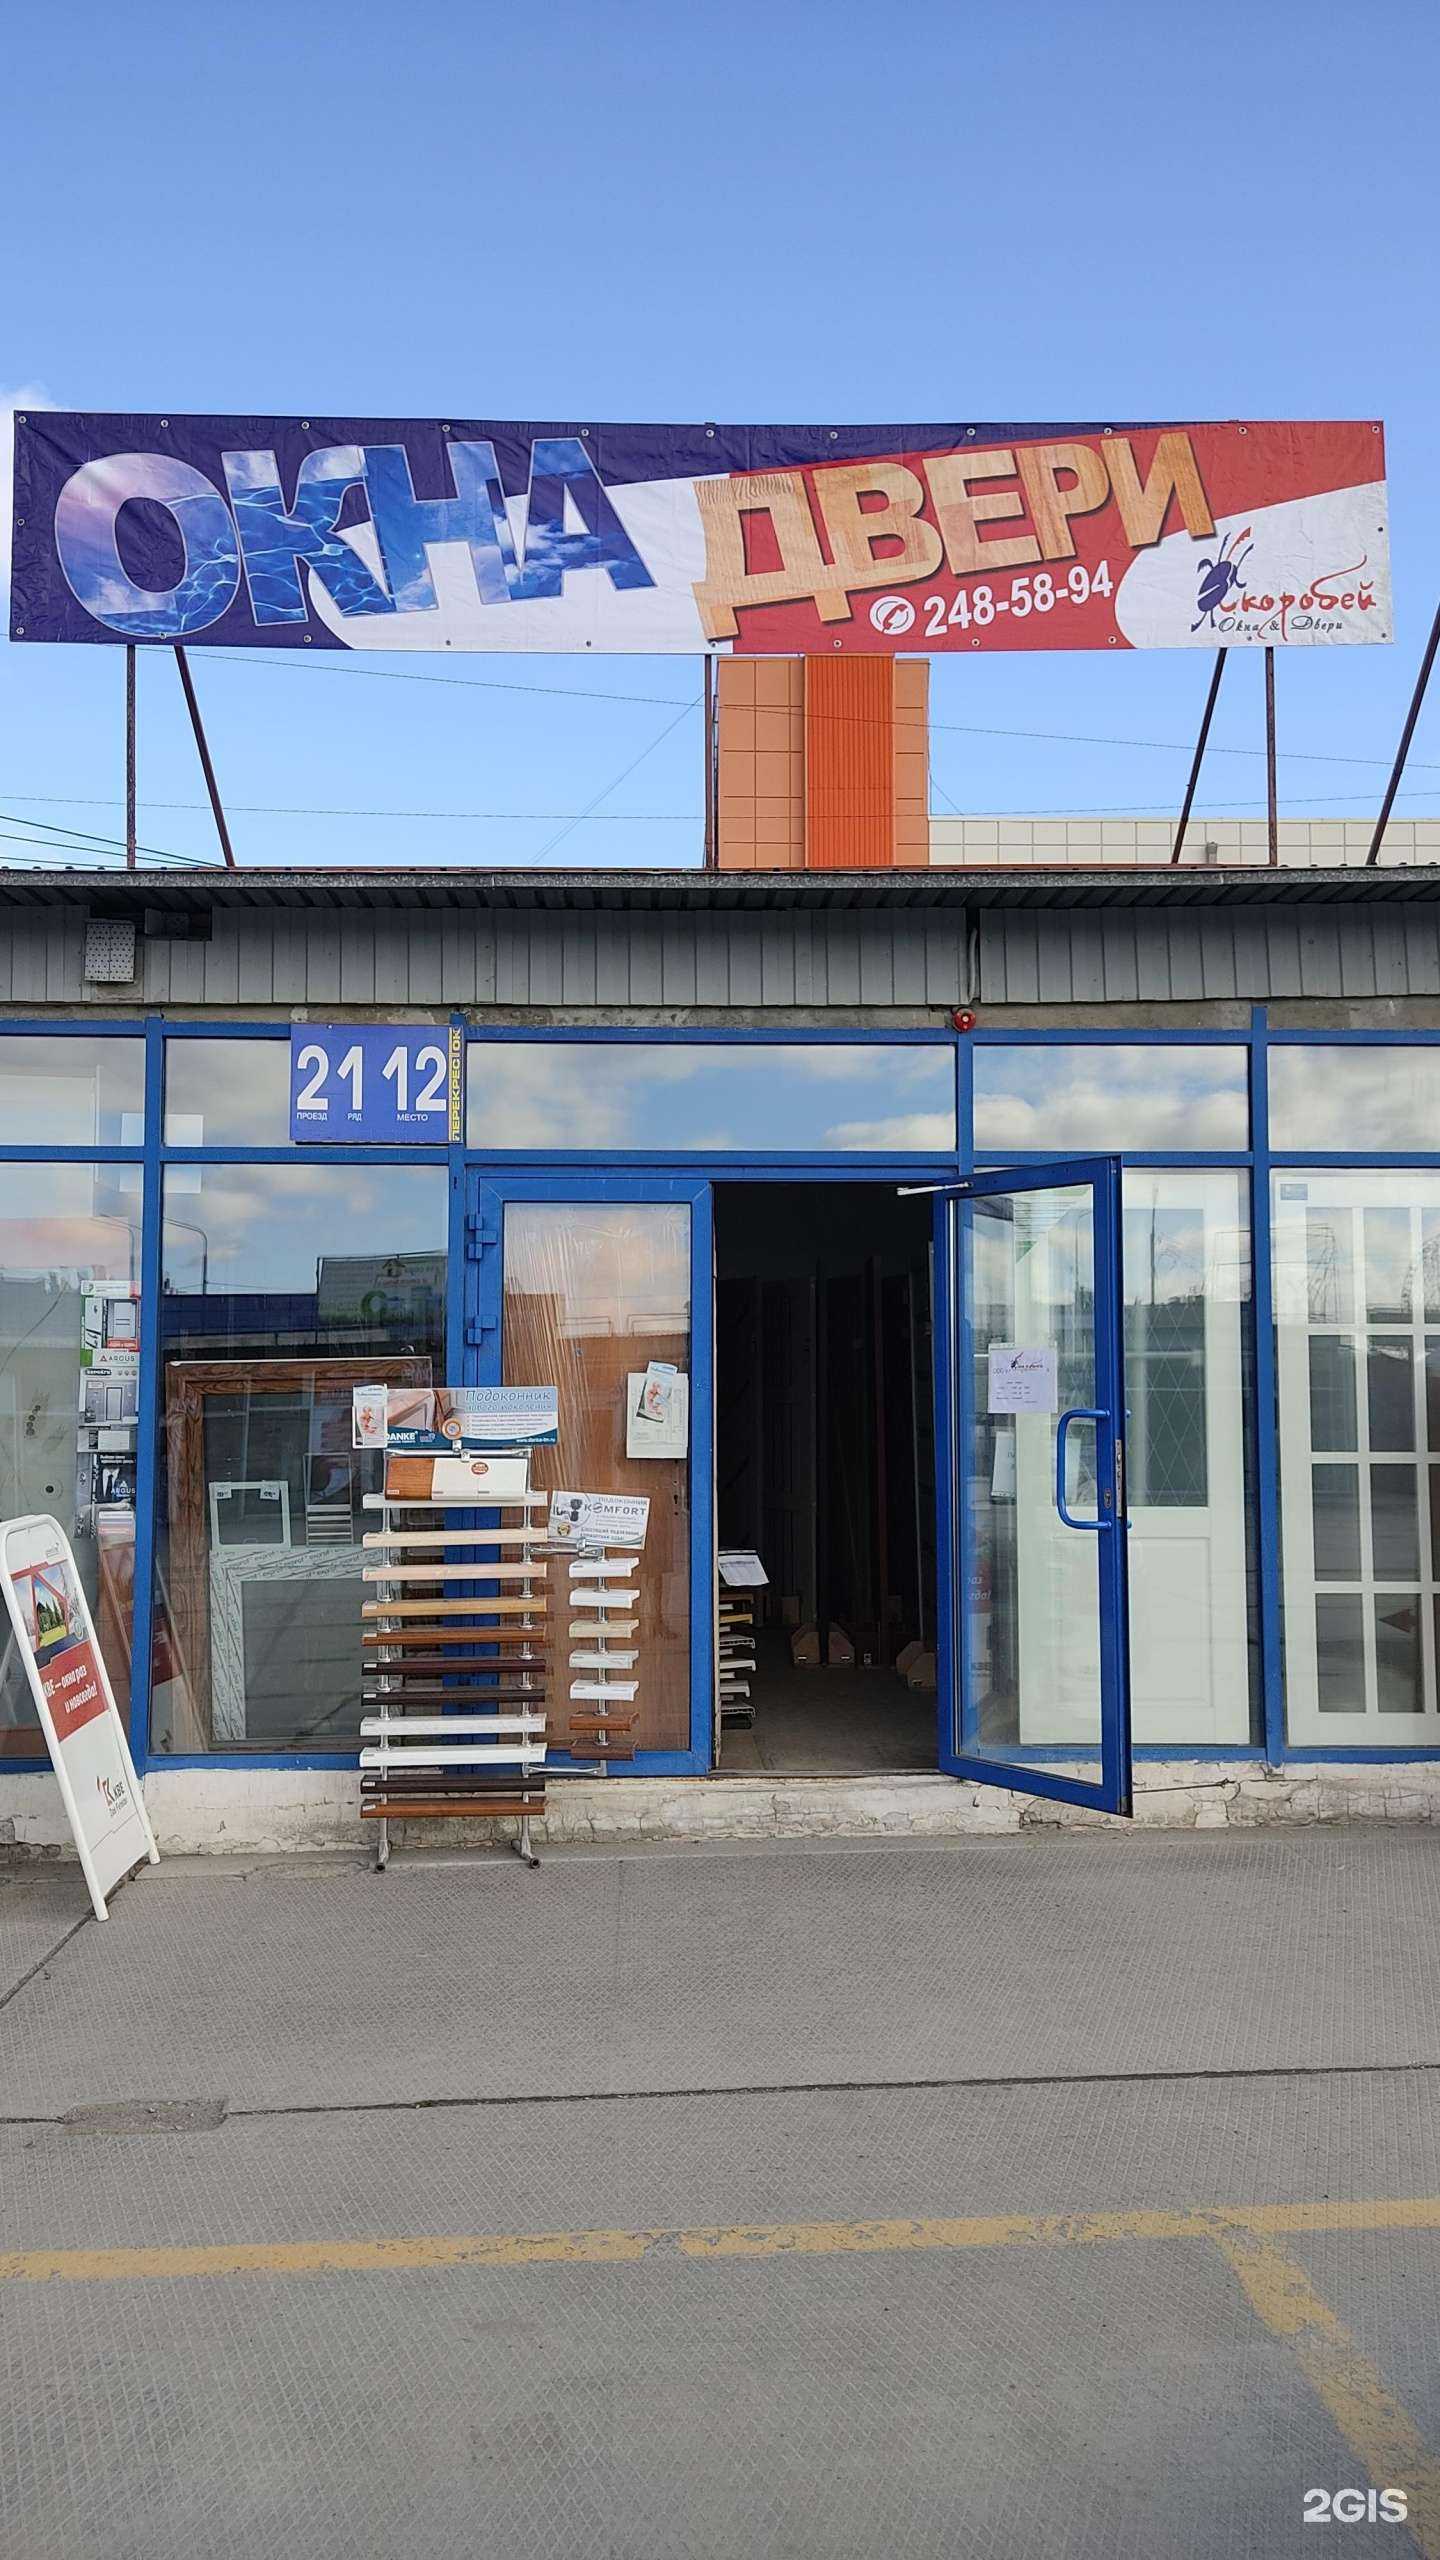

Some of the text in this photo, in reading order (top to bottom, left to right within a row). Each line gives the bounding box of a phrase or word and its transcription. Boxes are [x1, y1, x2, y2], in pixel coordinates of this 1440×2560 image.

[54, 438, 658, 638] ОКНА
[690, 431, 1217, 641] ДВЕРИ
[924, 560, 1114, 637] 248-58-94
[1218, 615, 1343, 633] Окна & Двери
[382, 1046, 447, 1111] 12
[451, 1026, 461, 1141] ПЕРЕКРЕСТОК
[296, 1112, 429, 1122] ПРОЕЗД РЯД МЕСТО
[465, 1389, 551, 1402] Подоконник
[75, 1664, 87, 1684] раз
